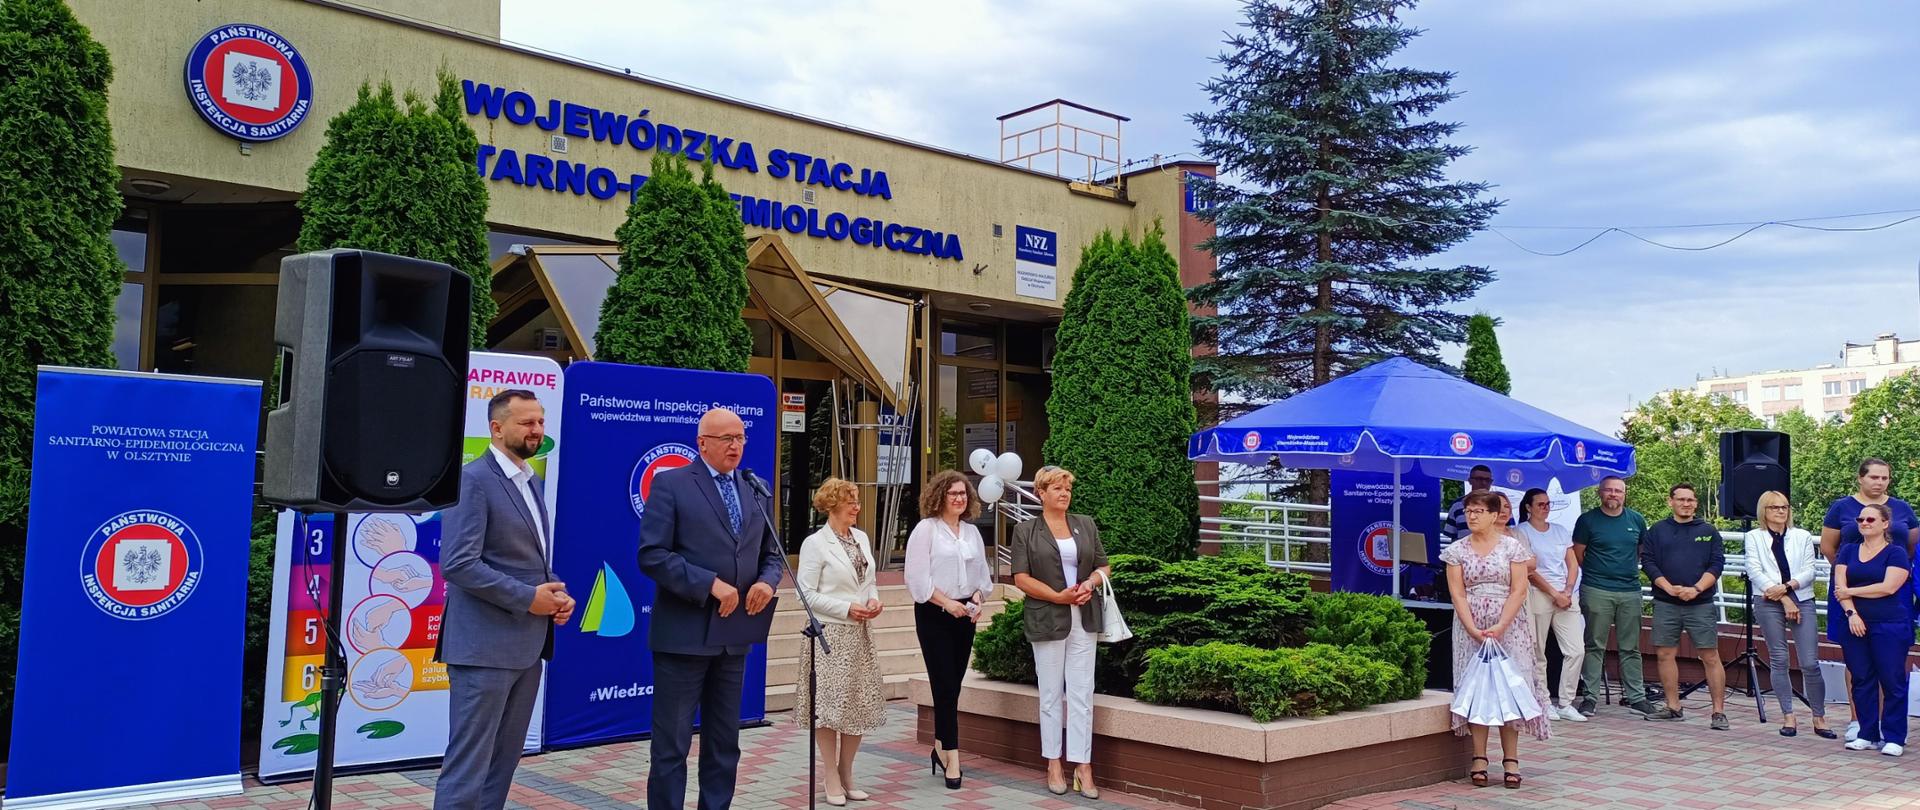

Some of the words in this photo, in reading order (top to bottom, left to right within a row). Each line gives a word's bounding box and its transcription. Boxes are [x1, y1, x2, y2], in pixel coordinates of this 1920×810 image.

[210, 26, 295, 60] PAŃSTWOWA
[191, 79, 247, 134] INSPEKCJA
[250, 99, 309, 136] SANITARNA
[462, 79, 759, 173] WOJEWÓDZKA
[767, 148, 892, 200] STACJA
[1025, 233, 1048, 251] NFZ
[467, 368, 557, 390] APRAWDĘ
[580, 393, 651, 410] Państwowa
[654, 399, 709, 416] Inspekcja
[591, 411, 651, 422] województwa
[92, 425, 166, 438] POWIATOWA
[169, 429, 209, 440] STACJA
[49, 436, 245, 453] SANITARNO-EPIDEMIOLOGICZNA
[644, 445, 697, 464] PAŃSTWOW
[107, 451, 119, 460] W
[124, 452, 192, 463] OLSZTYNIE
[102, 513, 185, 537] PAŃSTWOWA
[310, 528, 324, 556] 3
[84, 573, 137, 617] INSPEKCJA
[140, 570, 199, 617] SANITARNA
[304, 618, 318, 645] 5
[301, 663, 316, 692] 6
